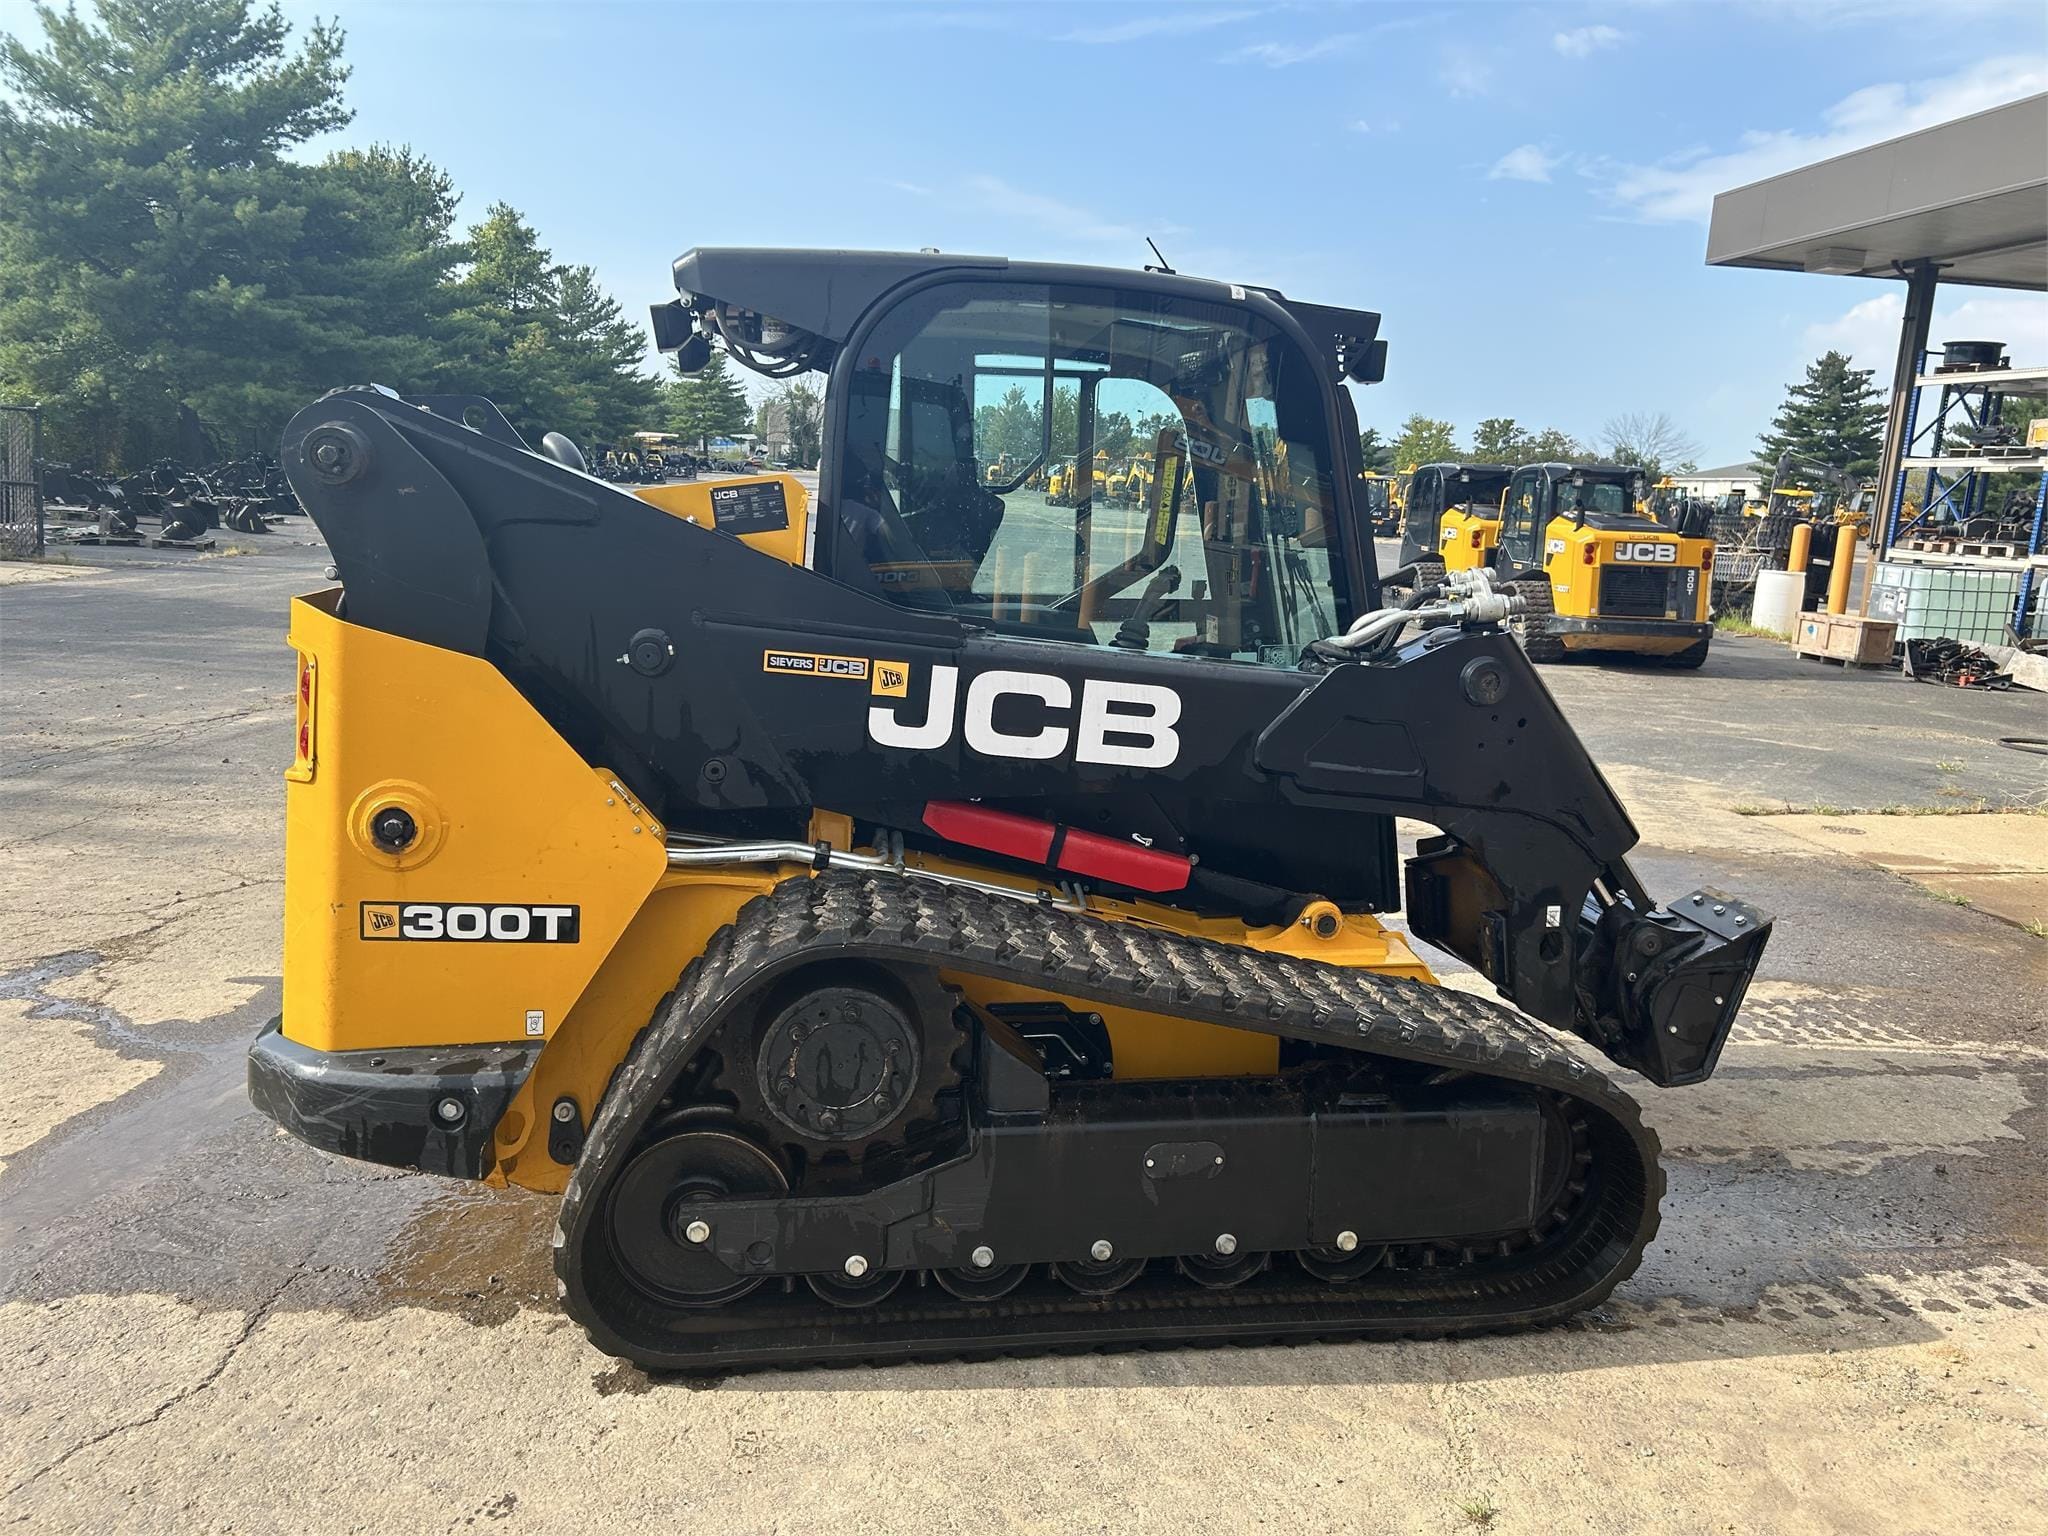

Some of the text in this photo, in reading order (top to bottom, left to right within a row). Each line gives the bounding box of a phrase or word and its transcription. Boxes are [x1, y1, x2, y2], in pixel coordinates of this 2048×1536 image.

[1802, 467, 1824, 475] VOLVO
[714, 490, 738, 500] JCB
[1615, 543, 1676, 562] JCB
[1687, 569, 1695, 596] 300T
[769, 656, 865, 675] SIEVERS JCB
[881, 669, 903, 688] JCB
[868, 665, 1182, 769] JCB
[373, 905, 573, 941] JCB 300T
